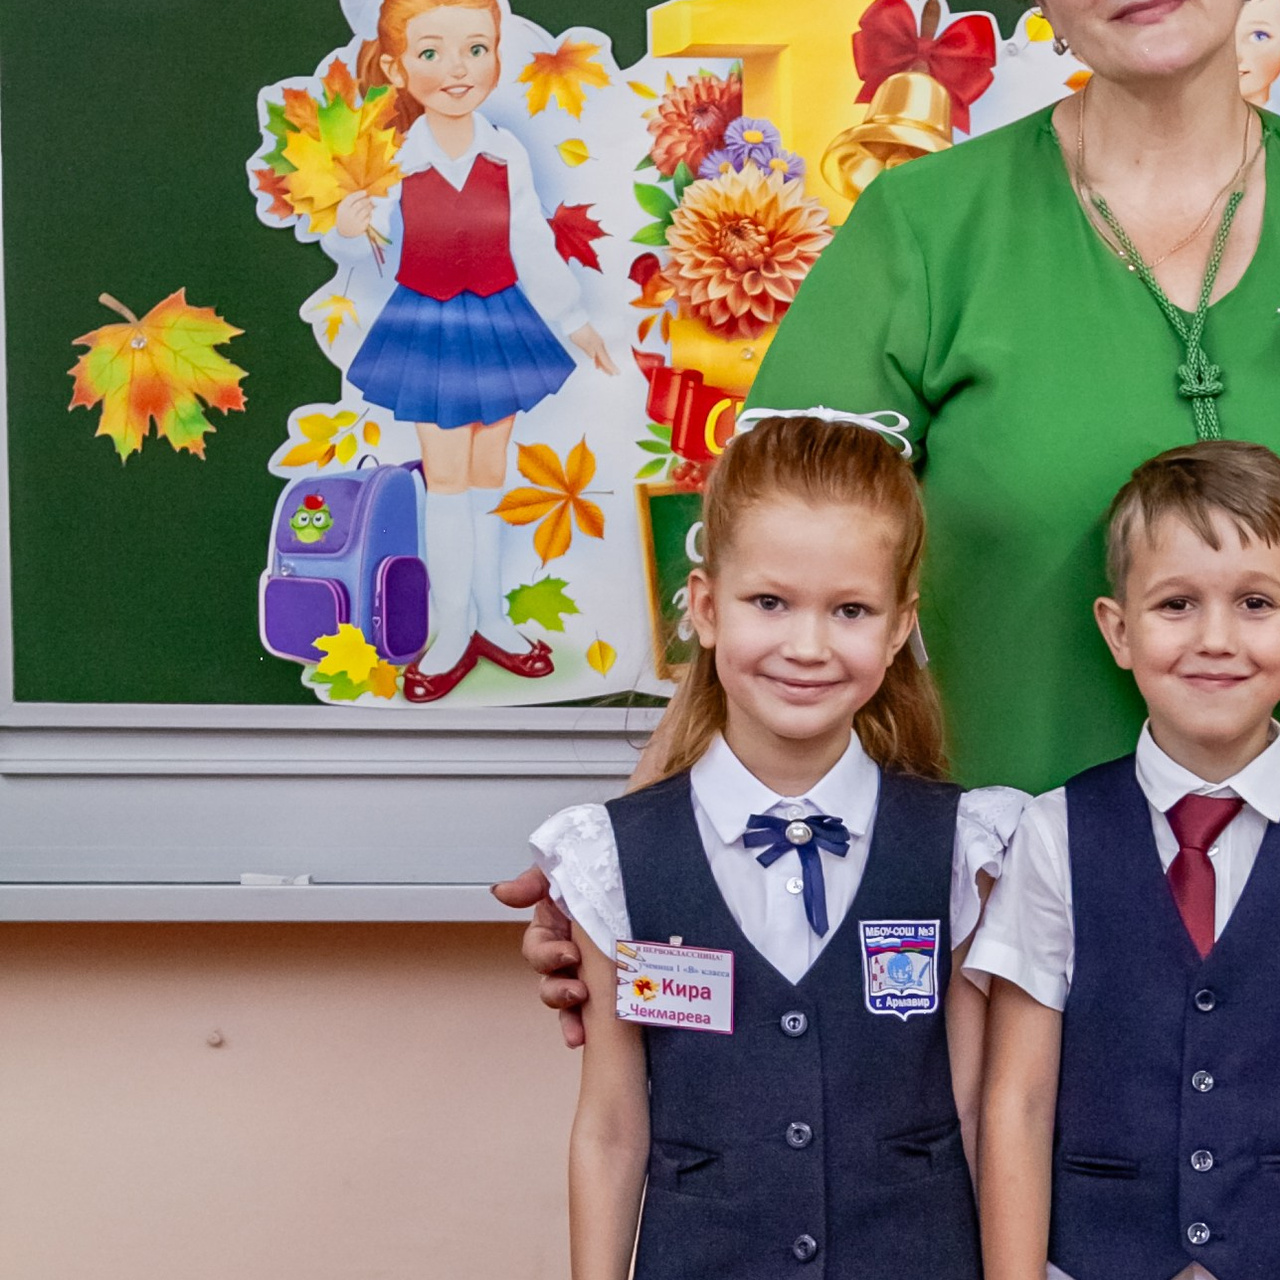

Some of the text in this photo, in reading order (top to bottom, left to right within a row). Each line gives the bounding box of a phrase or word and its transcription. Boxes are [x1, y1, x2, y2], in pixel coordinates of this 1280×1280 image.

[661, 978, 713, 1003] Кира
[630, 1003, 712, 1025] Чекмарева
[885, 996, 931, 1010] Армавир
